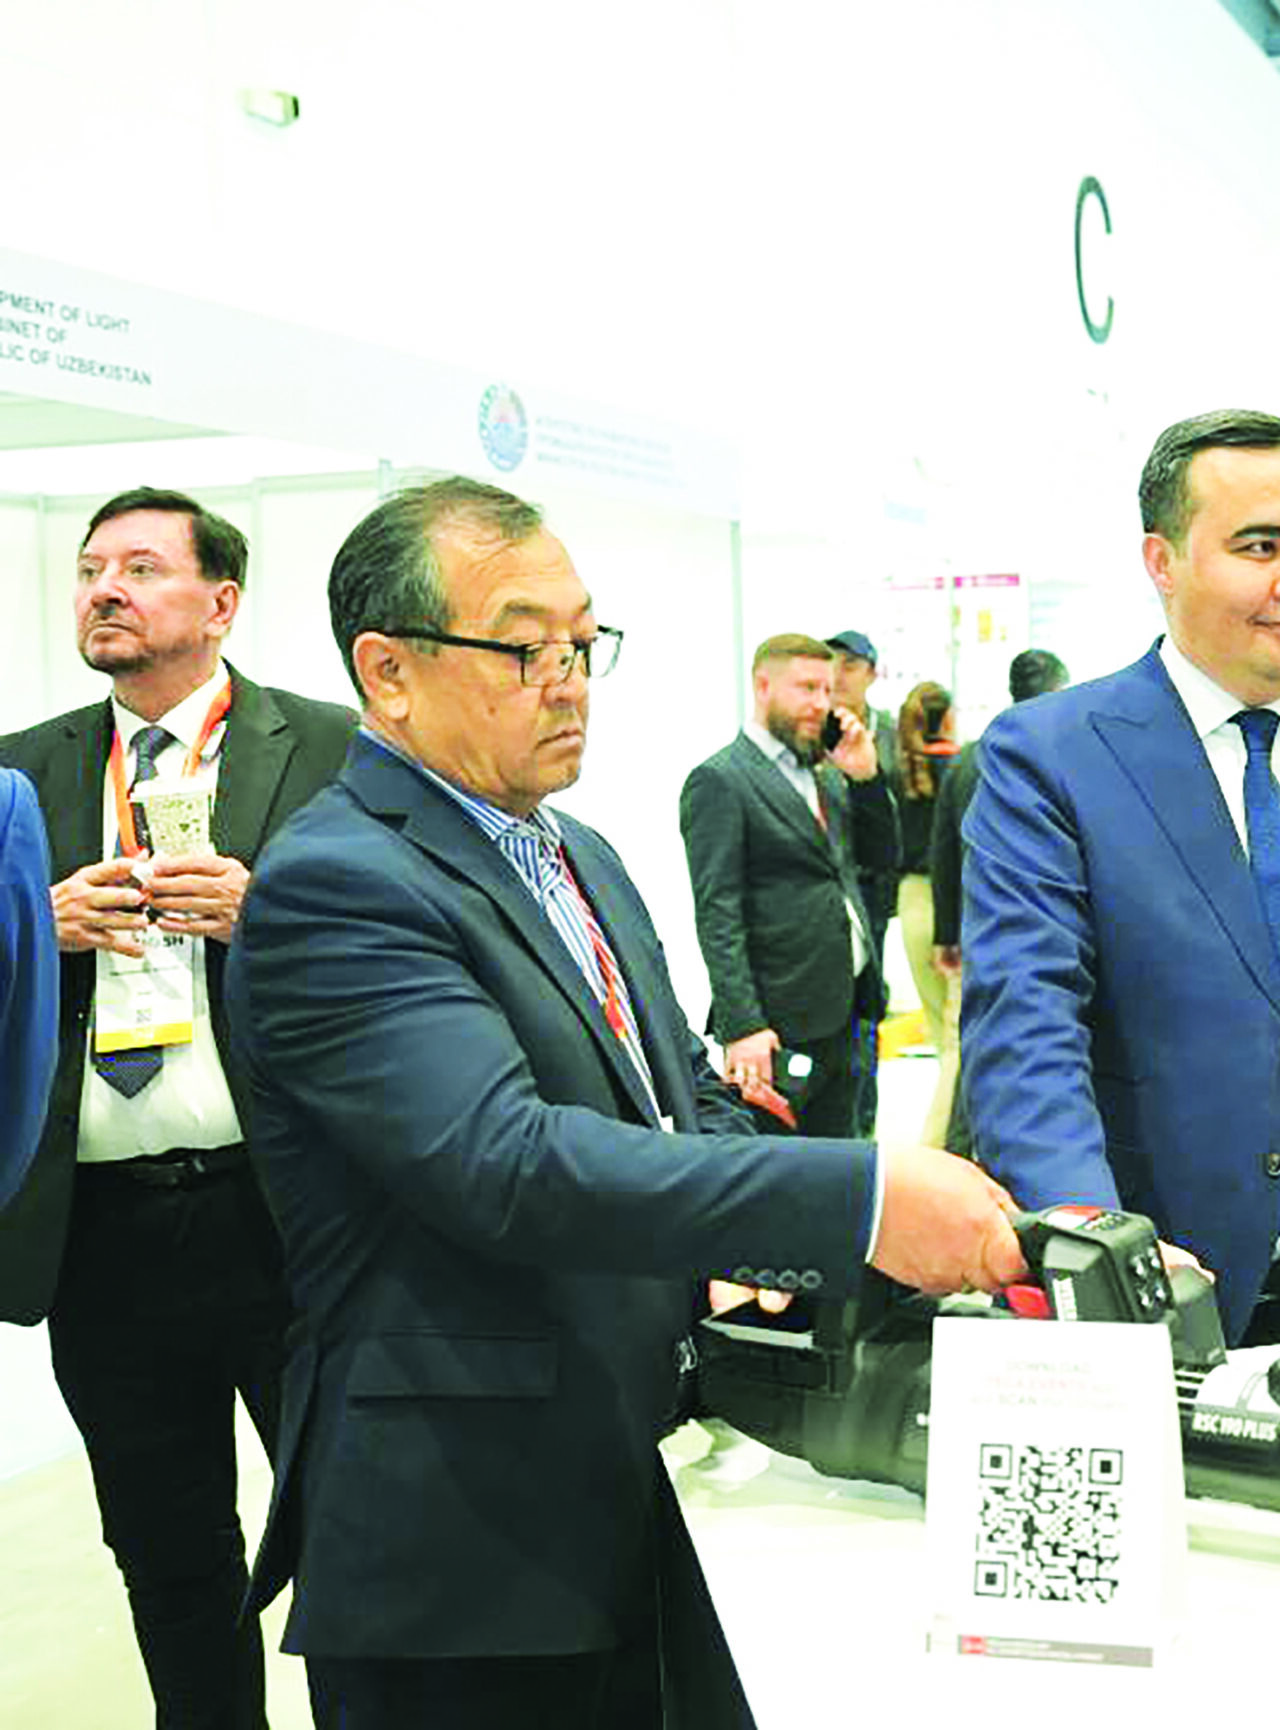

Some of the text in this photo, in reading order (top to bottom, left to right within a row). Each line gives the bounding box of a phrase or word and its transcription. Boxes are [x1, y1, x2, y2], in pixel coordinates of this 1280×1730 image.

[1074, 174, 1115, 344] C
[46, 326, 68, 344] OF
[59, 304, 80, 323] OF
[86, 310, 131, 333] LIGHT
[30, 348, 50, 365] OF
[56, 352, 152, 385] UZBEKISTAN
